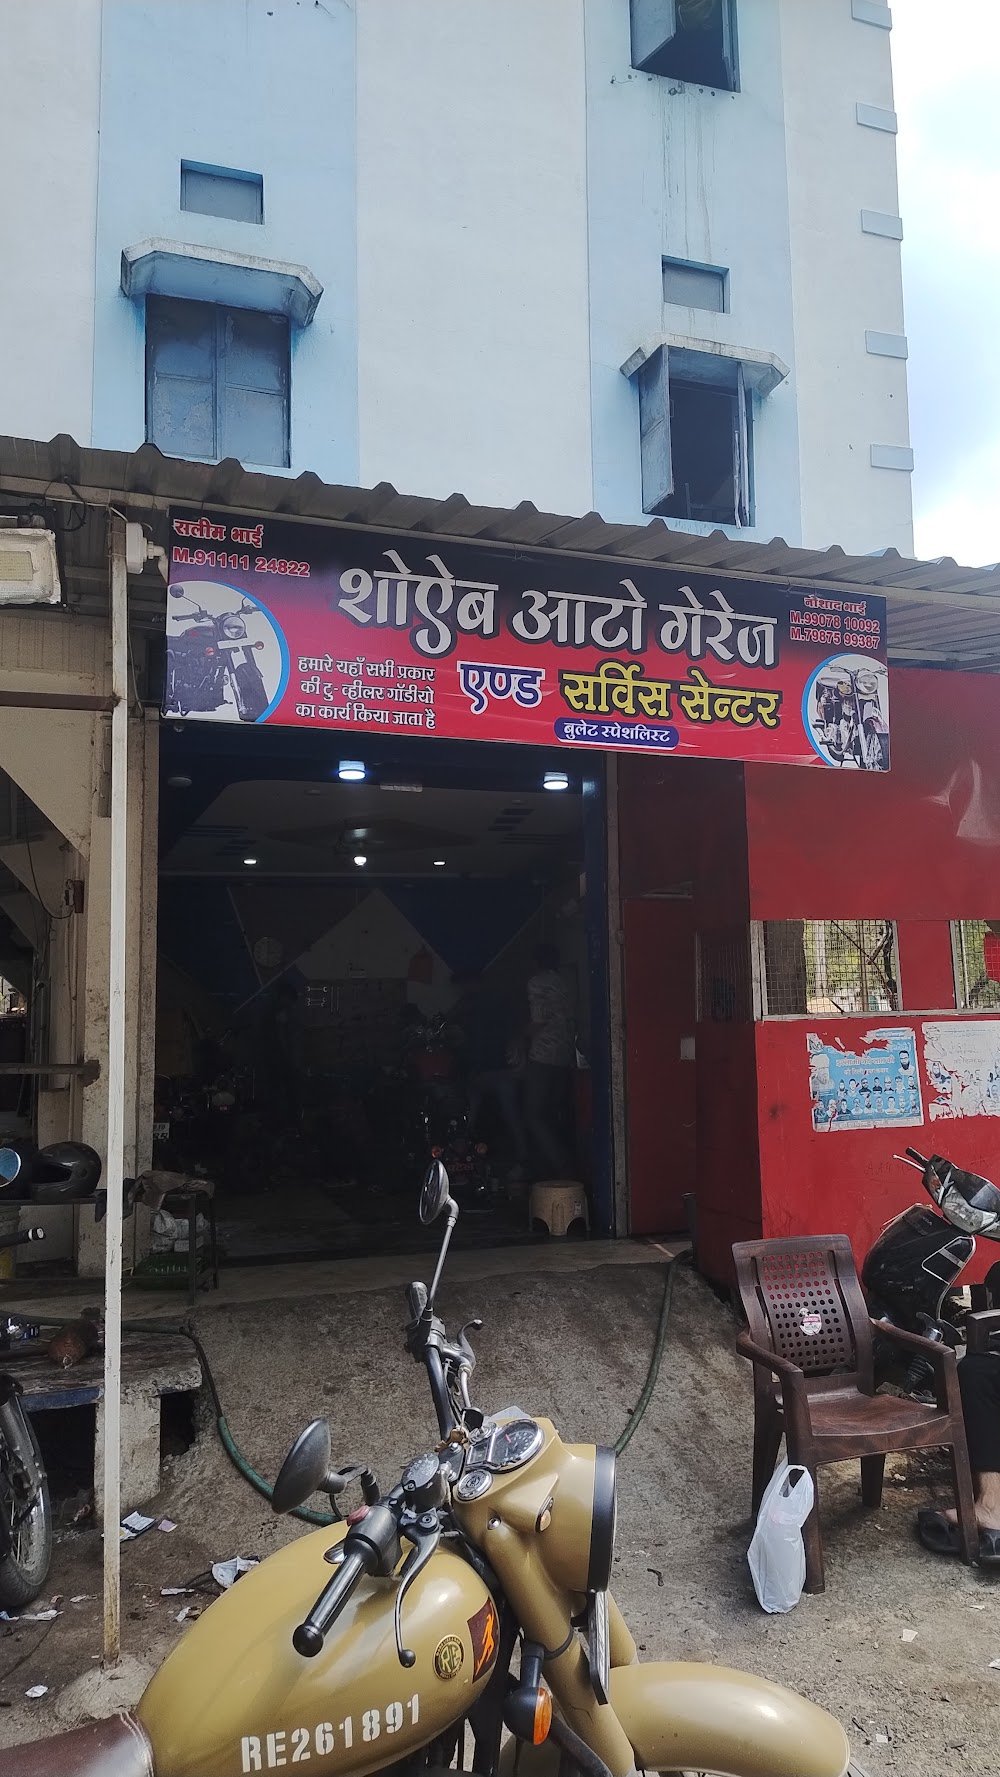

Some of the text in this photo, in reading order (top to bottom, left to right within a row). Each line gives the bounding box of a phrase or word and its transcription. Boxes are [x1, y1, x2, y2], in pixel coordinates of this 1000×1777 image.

[173, 517, 264, 548] सलीम भाई
[172, 546, 310, 577] M.91111 24822
[338, 550, 778, 666] शोऐब आटो गेरेज
[789, 610, 881, 633] M.99078 10092
[843, 600, 866, 616] भाई
[789, 626, 880, 649] M.79875 99387
[298, 654, 334, 673] हमारे
[366, 659, 395, 678] सभी
[397, 665, 436, 682] प्रकार
[300, 676, 320, 694] की
[457, 661, 779, 726] एण्ड सर्विस सेन्टर
[295, 702, 436, 729] का कार्य किया जाता है
[563, 719, 671, 742] बुलेट स्पेशलिस्ट
[241, 1693, 419, 1773] RE261891
